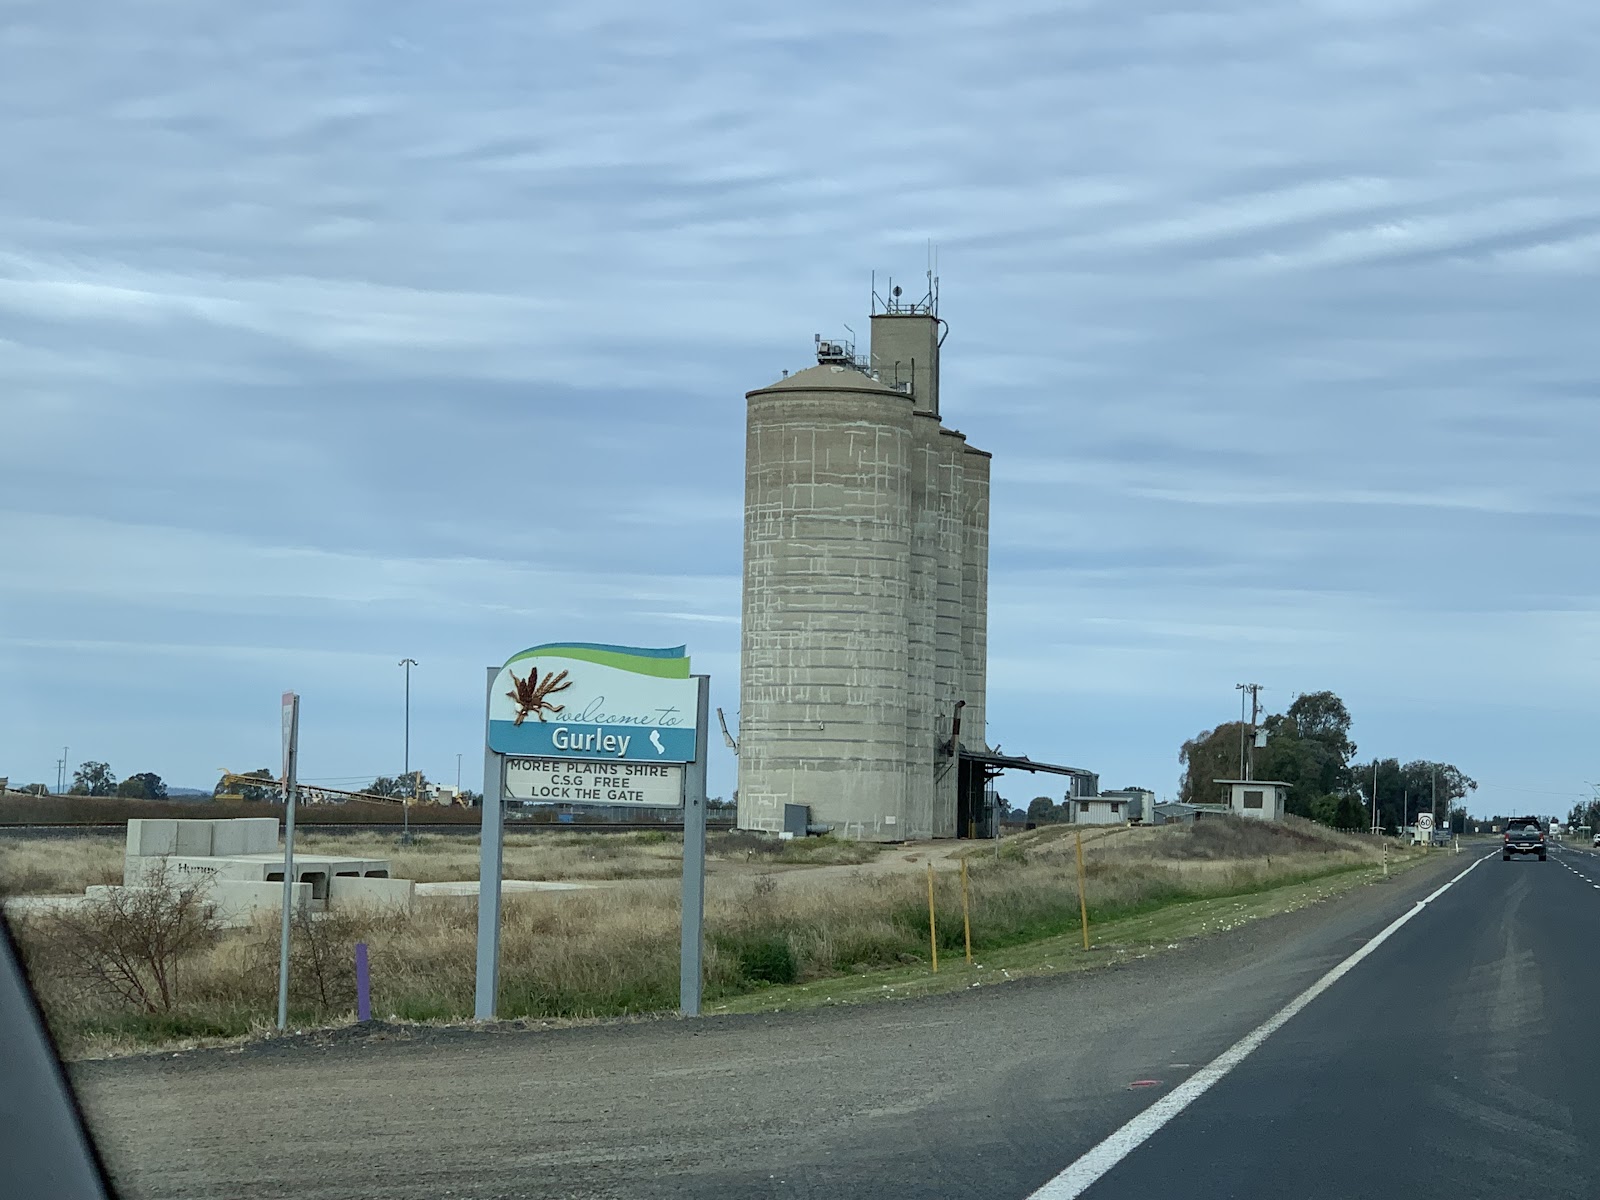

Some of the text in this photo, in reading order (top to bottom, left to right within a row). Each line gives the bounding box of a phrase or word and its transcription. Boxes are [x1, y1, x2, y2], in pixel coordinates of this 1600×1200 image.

[556, 696, 684, 726] welcome to
[552, 728, 631, 757] Gurley
[510, 760, 669, 777] MOREE PLAINS SHIRE
[594, 777, 630, 788] FREE
[531, 786, 644, 801] LOCK THE GATE
[1420, 818, 1430, 826] 60
